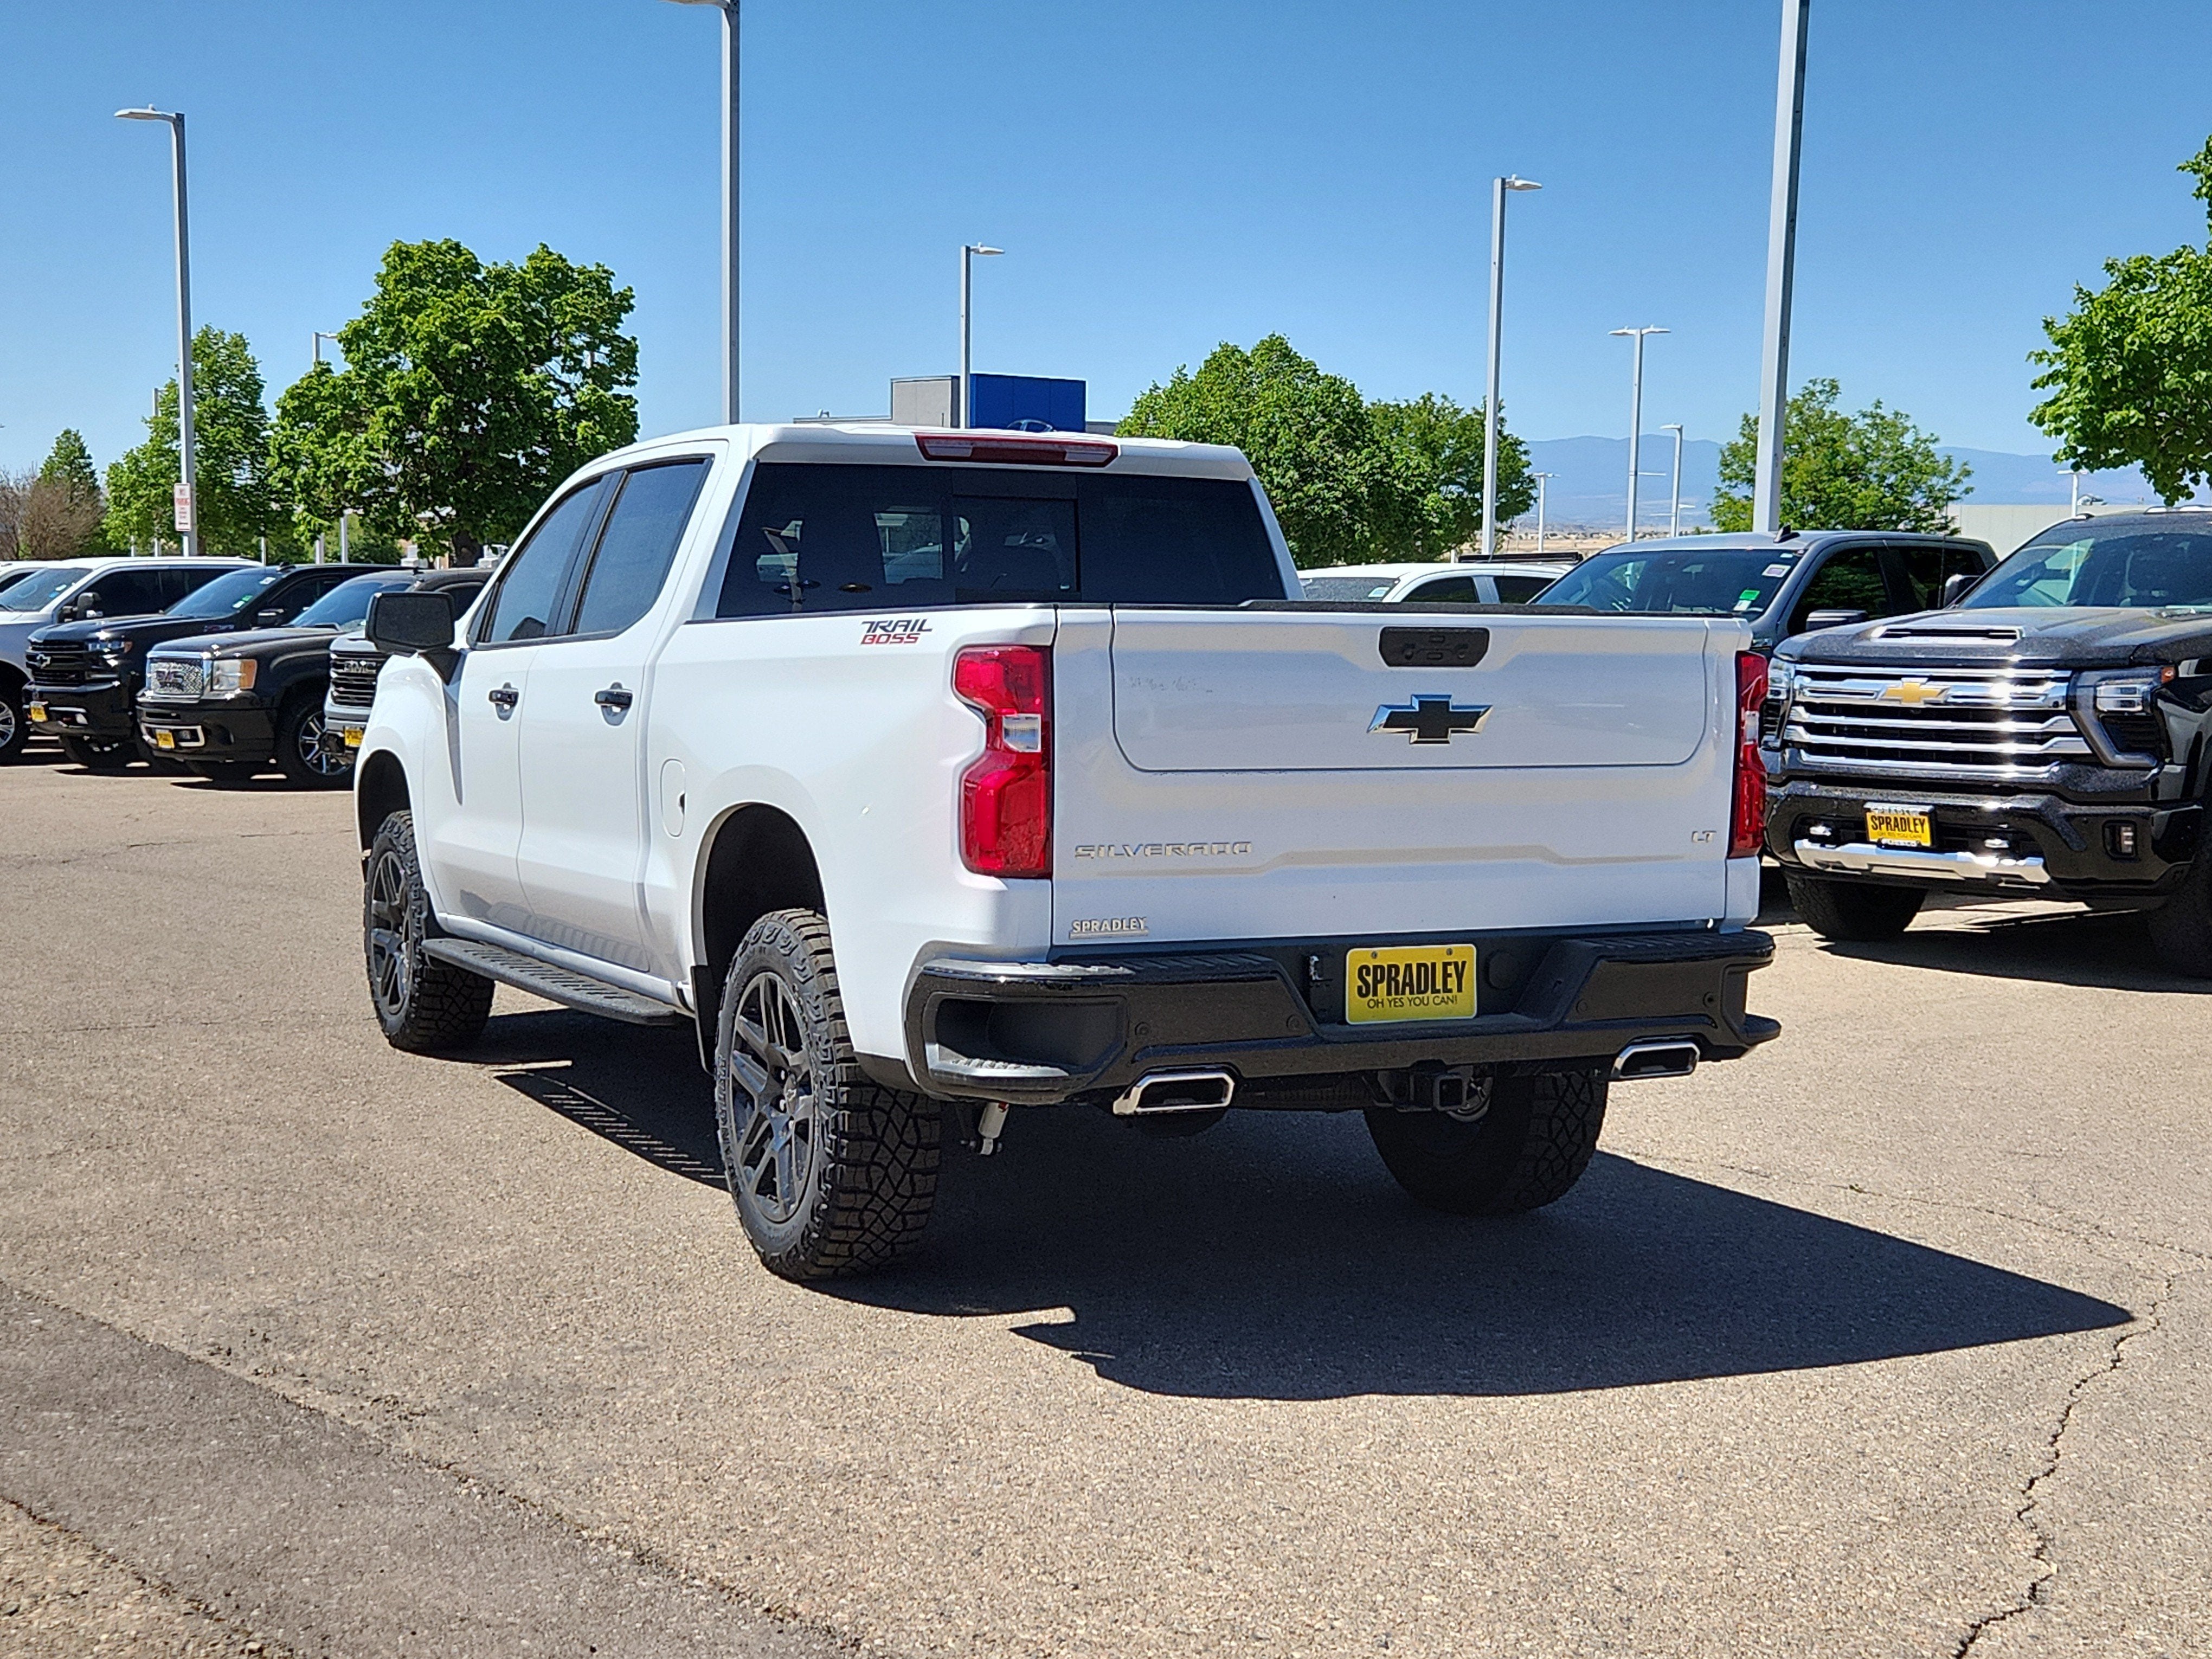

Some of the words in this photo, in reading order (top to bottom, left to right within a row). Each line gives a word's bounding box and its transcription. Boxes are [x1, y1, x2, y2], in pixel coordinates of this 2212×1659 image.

[861, 618, 933, 633] TRAIL
[860, 633, 921, 645] BOSS
[1870, 815, 1925, 833] SPRADLEY
[1692, 830, 1717, 843] LT
[1075, 841, 1252, 858] SILVERADO
[1072, 916, 1148, 933] SPRADLEY
[1357, 961, 1467, 998] SPRADLEY
[1367, 999, 1384, 1009] OH
[1387, 998, 1404, 1008] YES
[1406, 996, 1429, 1006] YOU
[1432, 995, 1457, 1006] CAN!
